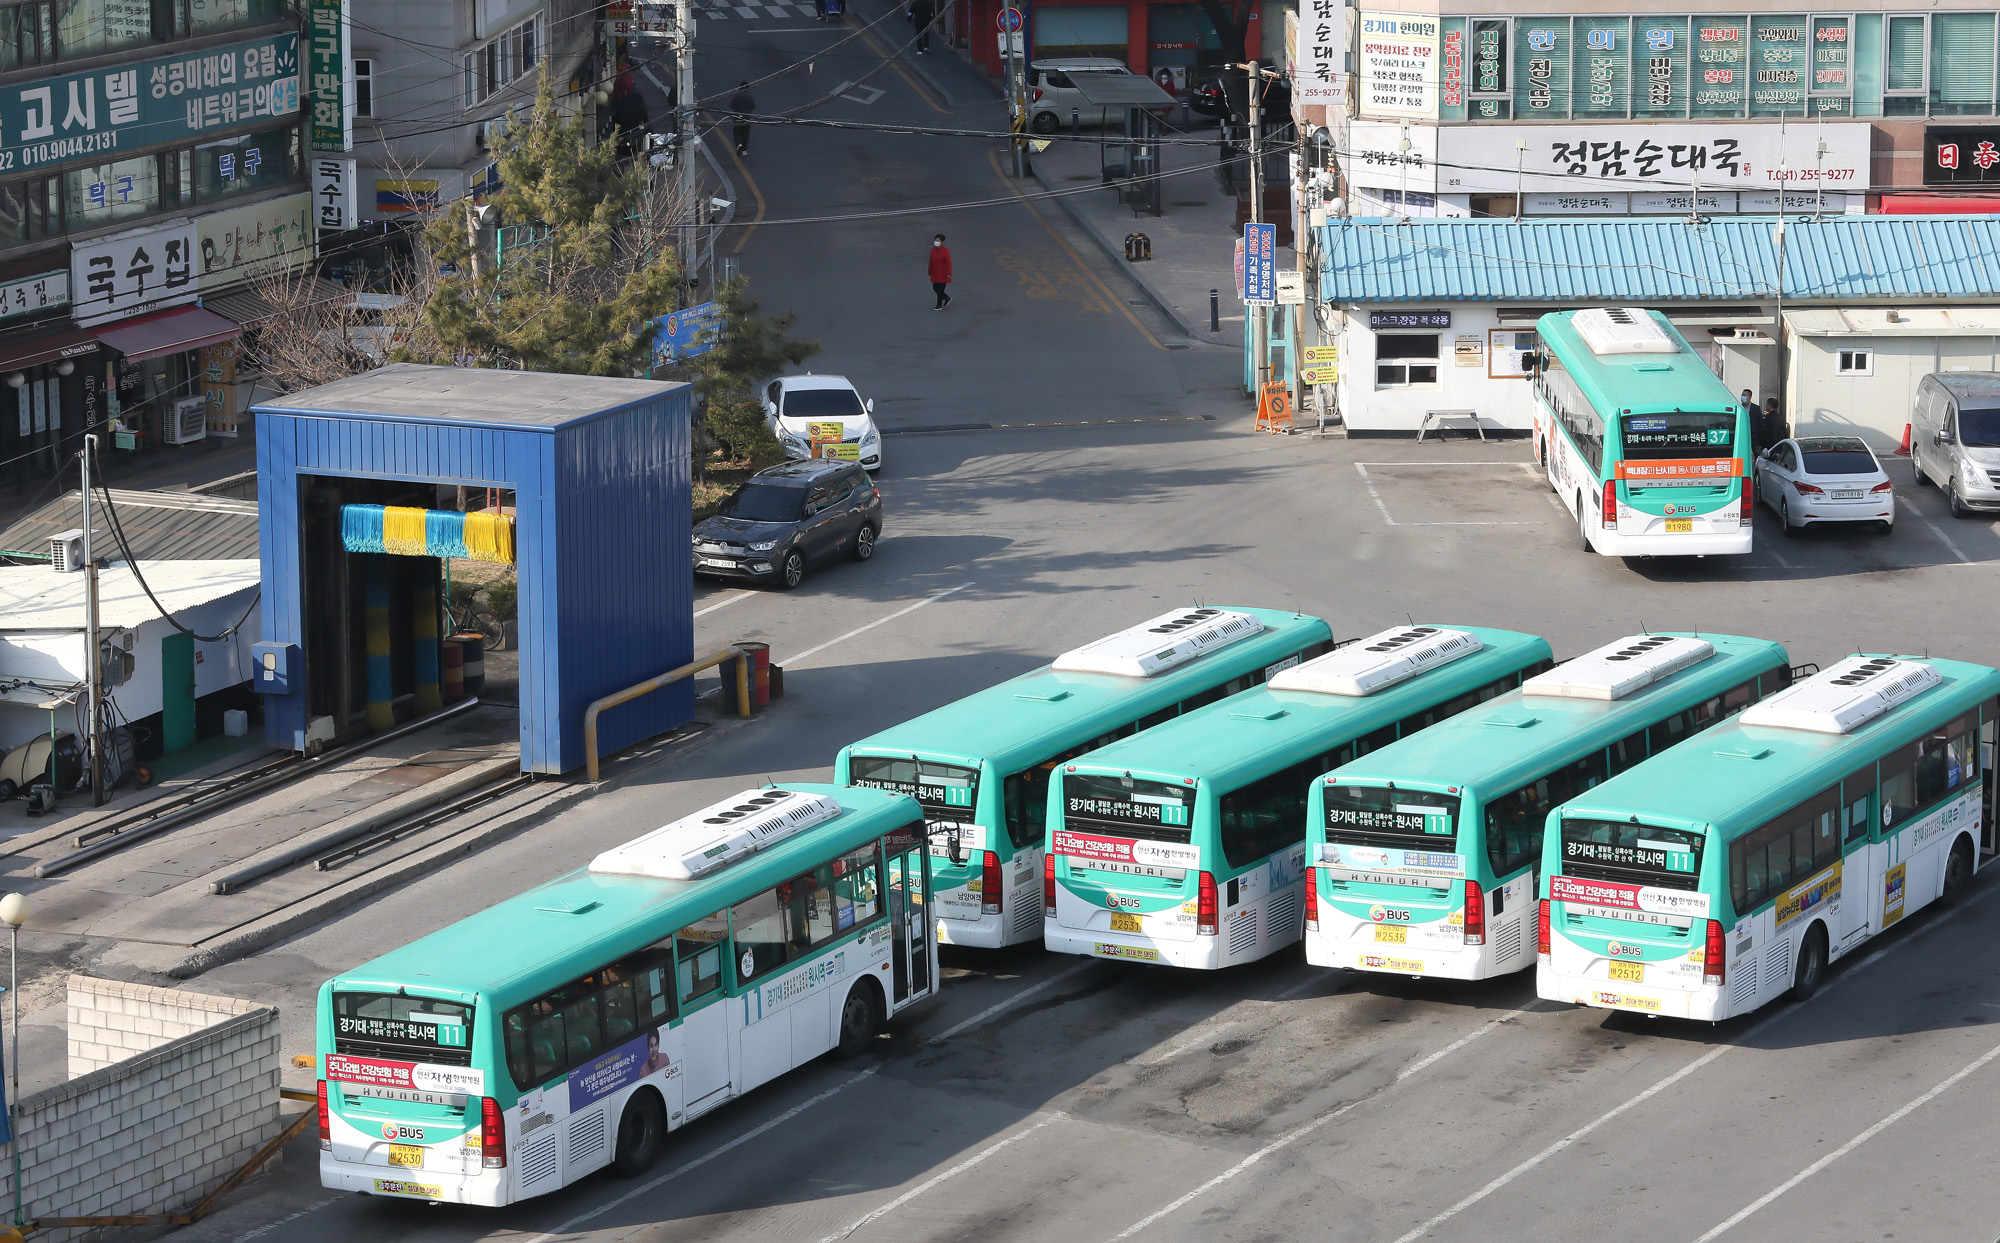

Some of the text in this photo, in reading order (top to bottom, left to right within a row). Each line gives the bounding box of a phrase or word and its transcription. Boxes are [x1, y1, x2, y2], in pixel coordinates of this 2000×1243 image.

[1363, 19, 1435, 37] 경기대 한의원
[1700, 28, 1738, 42] 갱년기
[1758, 28, 1799, 42] 구안와사
[1816, 27, 1846, 42] 수험생
[1365, 43, 1432, 57] 봉약침치료 전문
[1763, 49, 1793, 63] 중풍
[1816, 49, 1845, 62] 아토피
[1401, 60, 1426, 69] 디스크
[1443, 30, 1462, 106] 교통사고보험
[150, 45, 277, 99] 성공미래의 요람
[1373, 70, 1423, 82] 척추관 협착증
[1480, 30, 1499, 117] 지정한의원
[1704, 69, 1733, 83] 불임
[1305, 88, 1341, 96] 255-9277
[1696, 90, 1740, 105] 산후보약
[21, 69, 139, 142] 고시텔
[187, 78, 298, 130] 네트워크의 산실
[1373, 95, 1397, 104] 오십견
[1406, 97, 1422, 107] 통풍
[1816, 97, 1842, 112] 면역
[315, 130, 326, 139] 2F
[22, 131, 118, 166] 010.9044.2131
[219, 148, 261, 181] 탁구
[1552, 139, 1742, 177] 정담순대국
[1800, 168, 1855, 181] 255-9277
[90, 176, 134, 207] 탁구
[319, 161, 342, 227] 국수집
[1557, 197, 1610, 210] 정담순대국
[1666, 197, 1718, 209] 정담순대국
[1773, 196, 1826, 208] 정담순대국
[86, 236, 190, 304] 국수집
[1249, 256, 1259, 294] 가족처럼
[1261, 261, 1271, 298] 생명처럼
[1372, 315, 1449, 326] 마스크,장갑 꼭 착용
[1266, 386, 1286, 394] 주차금지
[1709, 430, 1728, 444] 37
[1672, 523, 1692, 531] 1980
[918, 785, 965, 805] 원시역 11
[1069, 798, 1182, 823] 경기대 원시역 11
[1330, 809, 1446, 832] 경기대 원시역 11
[1055, 836, 1084, 849] 추나요법
[1085, 840, 1114, 853] 건강보험
[1115, 843, 1131, 855] 적용
[1150, 847, 1170, 859] 자생
[1567, 842, 1689, 870] 경기대 원시역 11
[1088, 861, 1163, 876] HYUNDAI
[1351, 873, 1428, 887] HYUNDAI
[957, 892, 982, 902] 남양여객
[1552, 882, 1635, 901] 추나요법 건강보험 적용
[1120, 897, 1140, 908] BUS
[1656, 894, 1706, 908] 자생 한방병원
[1386, 909, 1411, 921] BUS
[1587, 908, 1668, 925] HYUNDAI
[1118, 919, 1140, 931] 2531
[1438, 924, 1464, 934] 남양여객
[1382, 931, 1405, 942] 2535
[1608, 941, 1641, 956] G BUS
[1679, 963, 1702, 972] 남양여객
[1617, 969, 1641, 981] 2512
[741, 986, 762, 1027] 11
[767, 983, 783, 1008] 경기대
[808, 961, 826, 988] 원시역
[339, 1018, 459, 1045] 경기대 원시역 11
[328, 1061, 410, 1080] 추나요법 건강보험 적용
[431, 1072, 451, 1084] 자생
[453, 1075, 480, 1085] 한방병원
[363, 1087, 443, 1104] HYUNDAI
[382, 1122, 424, 1140] G BUS
[397, 1152, 421, 1164] 2530
[460, 1148, 482, 1157] 남양여객
